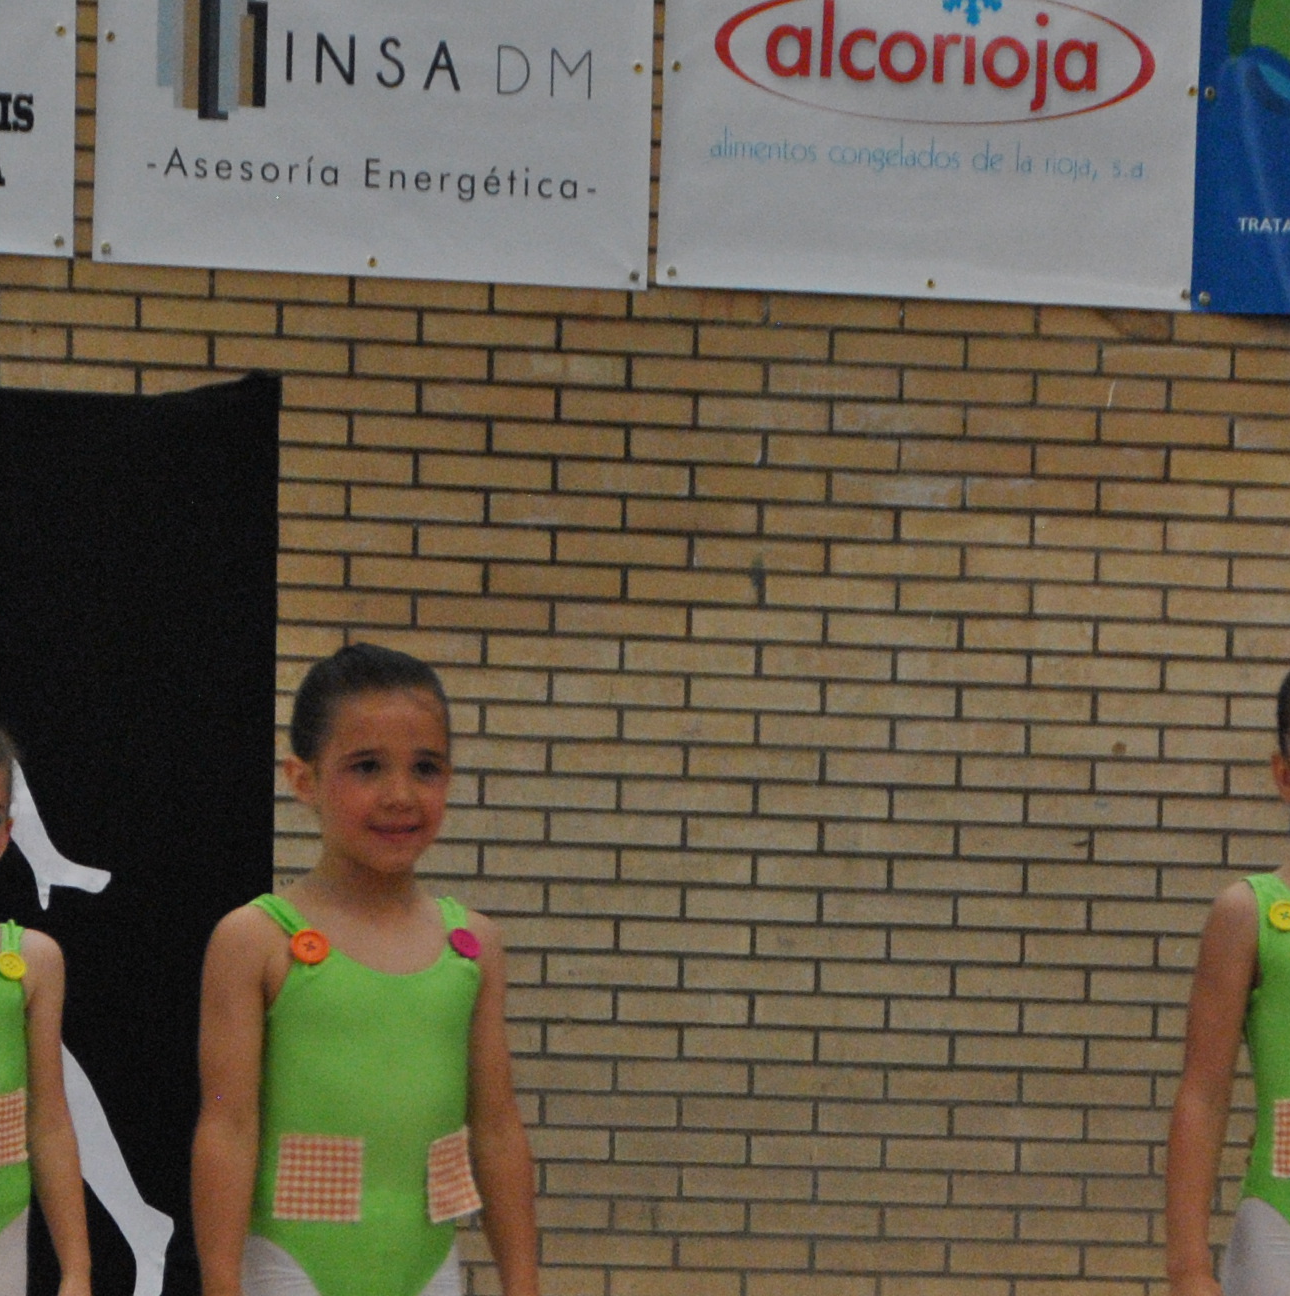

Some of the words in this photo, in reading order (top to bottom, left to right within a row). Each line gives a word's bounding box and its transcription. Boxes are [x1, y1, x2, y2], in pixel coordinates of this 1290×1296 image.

[286, 31, 461, 92] INSA
[496, 44, 593, 99] DM
[765, 0, 1098, 111] alcorioja
[710, 126, 817, 164] alimentos
[828, 136, 961, 174] congelados
[972, 141, 1004, 171] de
[1016, 140, 1033, 174] la
